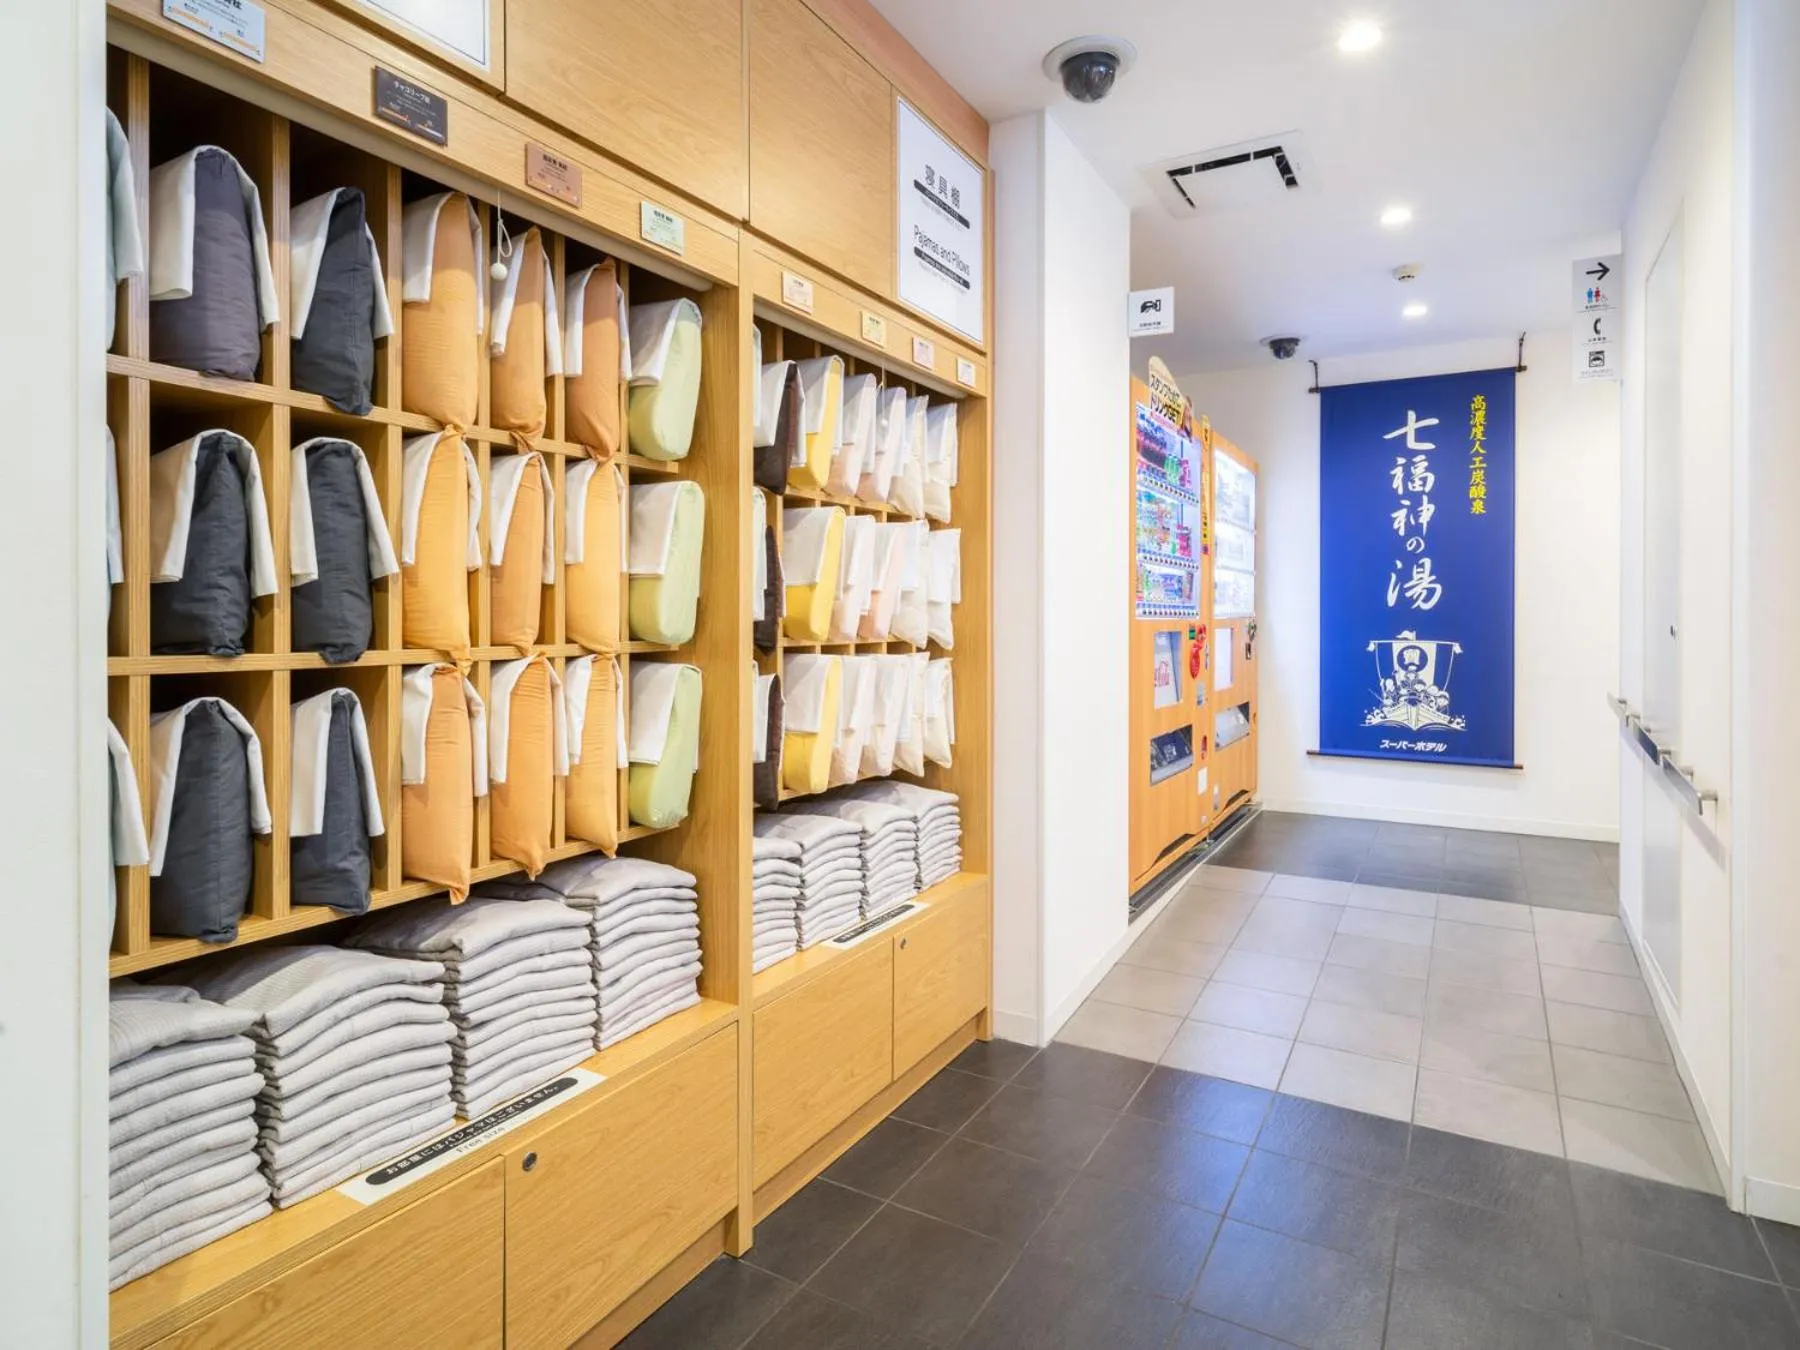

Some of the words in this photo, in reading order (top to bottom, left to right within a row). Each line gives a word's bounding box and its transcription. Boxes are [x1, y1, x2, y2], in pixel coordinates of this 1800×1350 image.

[914, 224, 939, 256] Pajamas
[952, 250, 970, 276] Pillows
[1469, 394, 1487, 514] 高濃度人工炭酸泉
[1382, 409, 1442, 611] 七福神の湯
[1379, 739, 1447, 752] スーパーホテル
